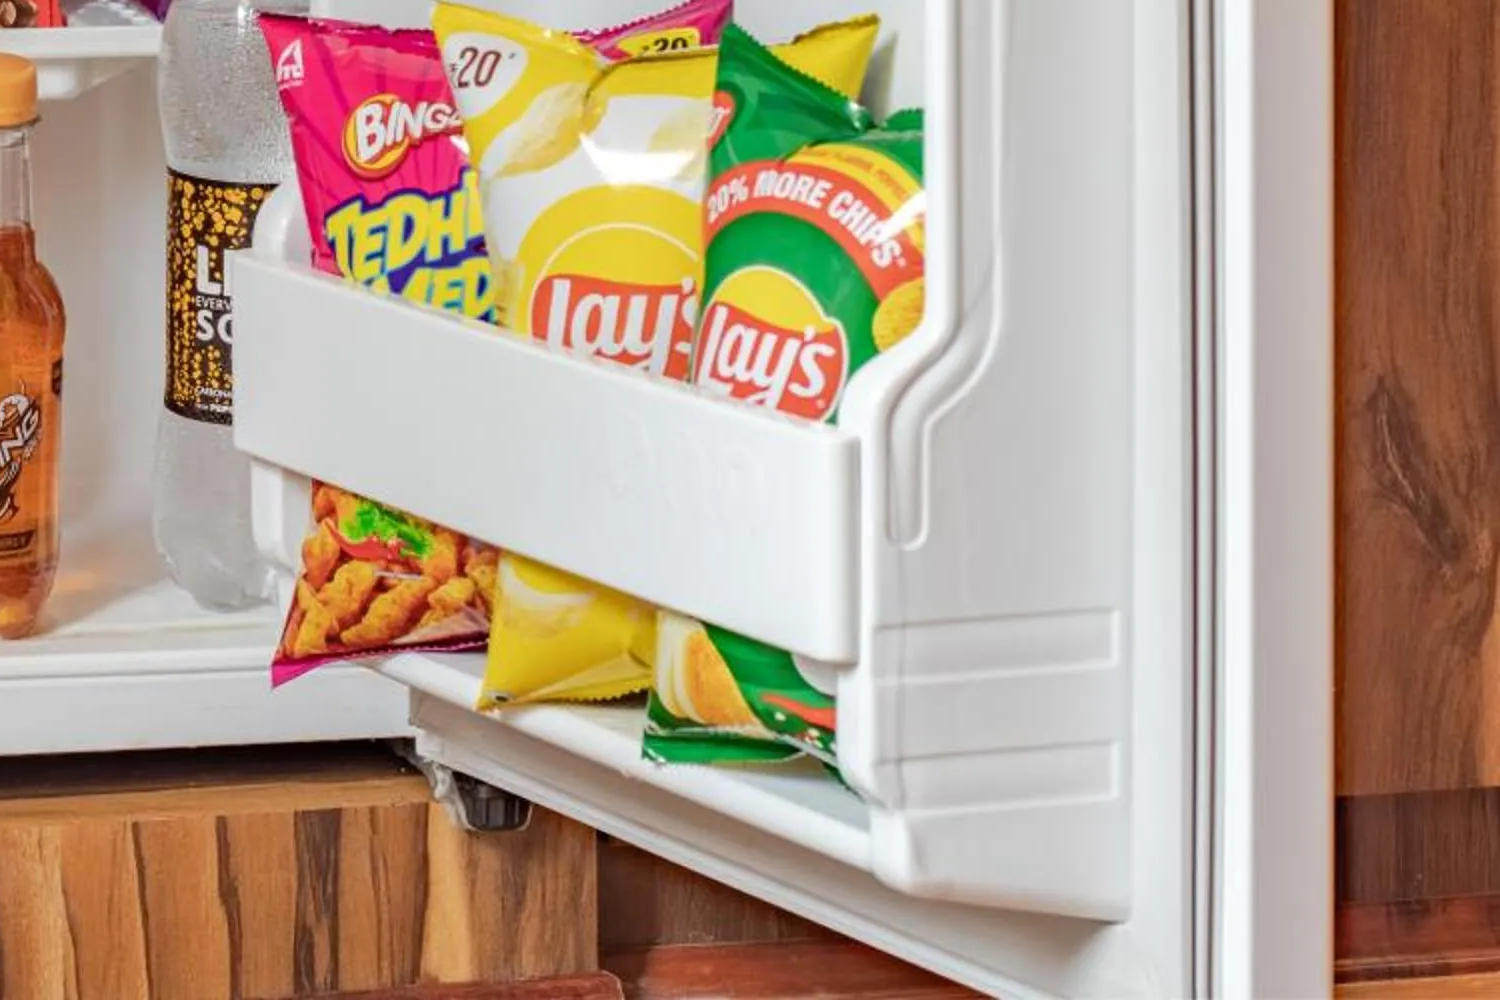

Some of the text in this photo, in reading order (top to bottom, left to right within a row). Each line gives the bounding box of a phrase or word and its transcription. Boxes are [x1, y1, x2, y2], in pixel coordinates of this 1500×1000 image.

[708, 174, 749, 223] 20%
[755, 169, 832, 209] MORE
[700, 305, 835, 412] Lay's
